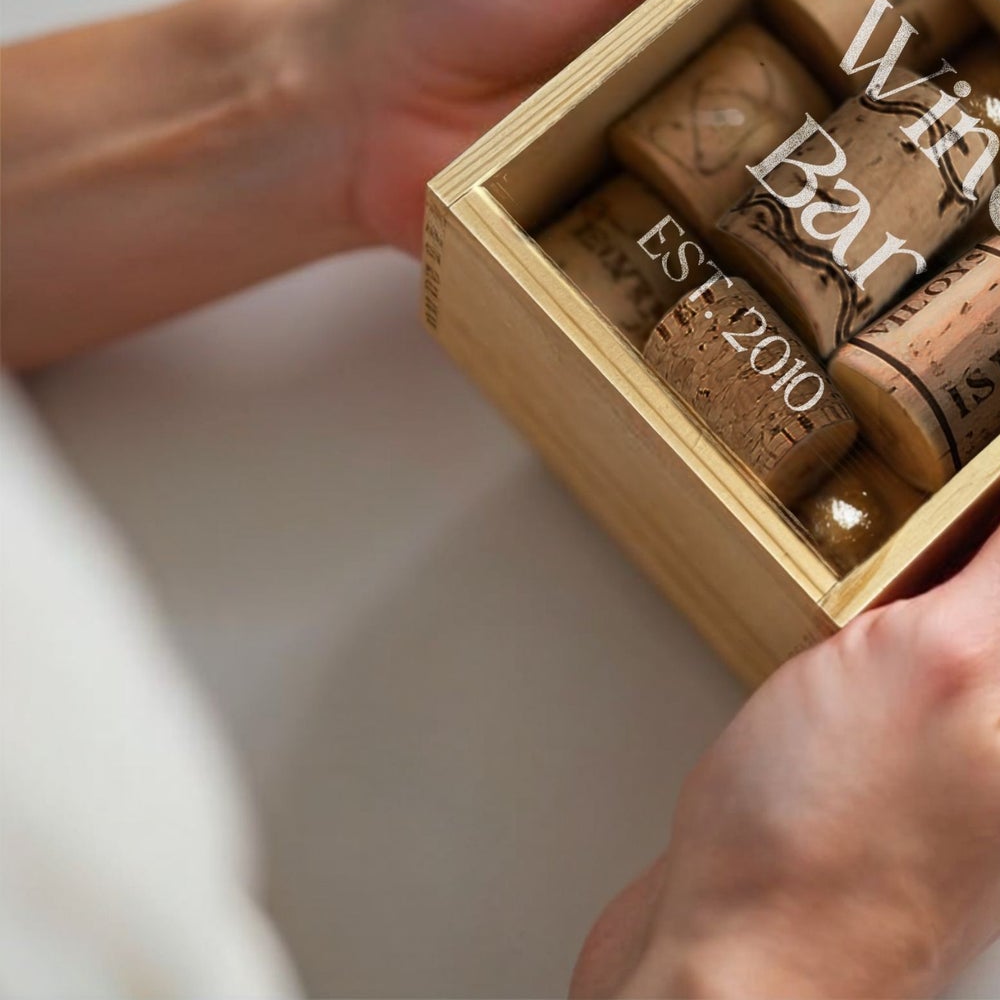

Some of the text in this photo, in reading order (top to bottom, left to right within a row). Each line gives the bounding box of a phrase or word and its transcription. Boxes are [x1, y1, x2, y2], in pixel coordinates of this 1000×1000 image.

[745, 112, 927, 291] Bar
[636, 214, 825, 412] EST. 2010
